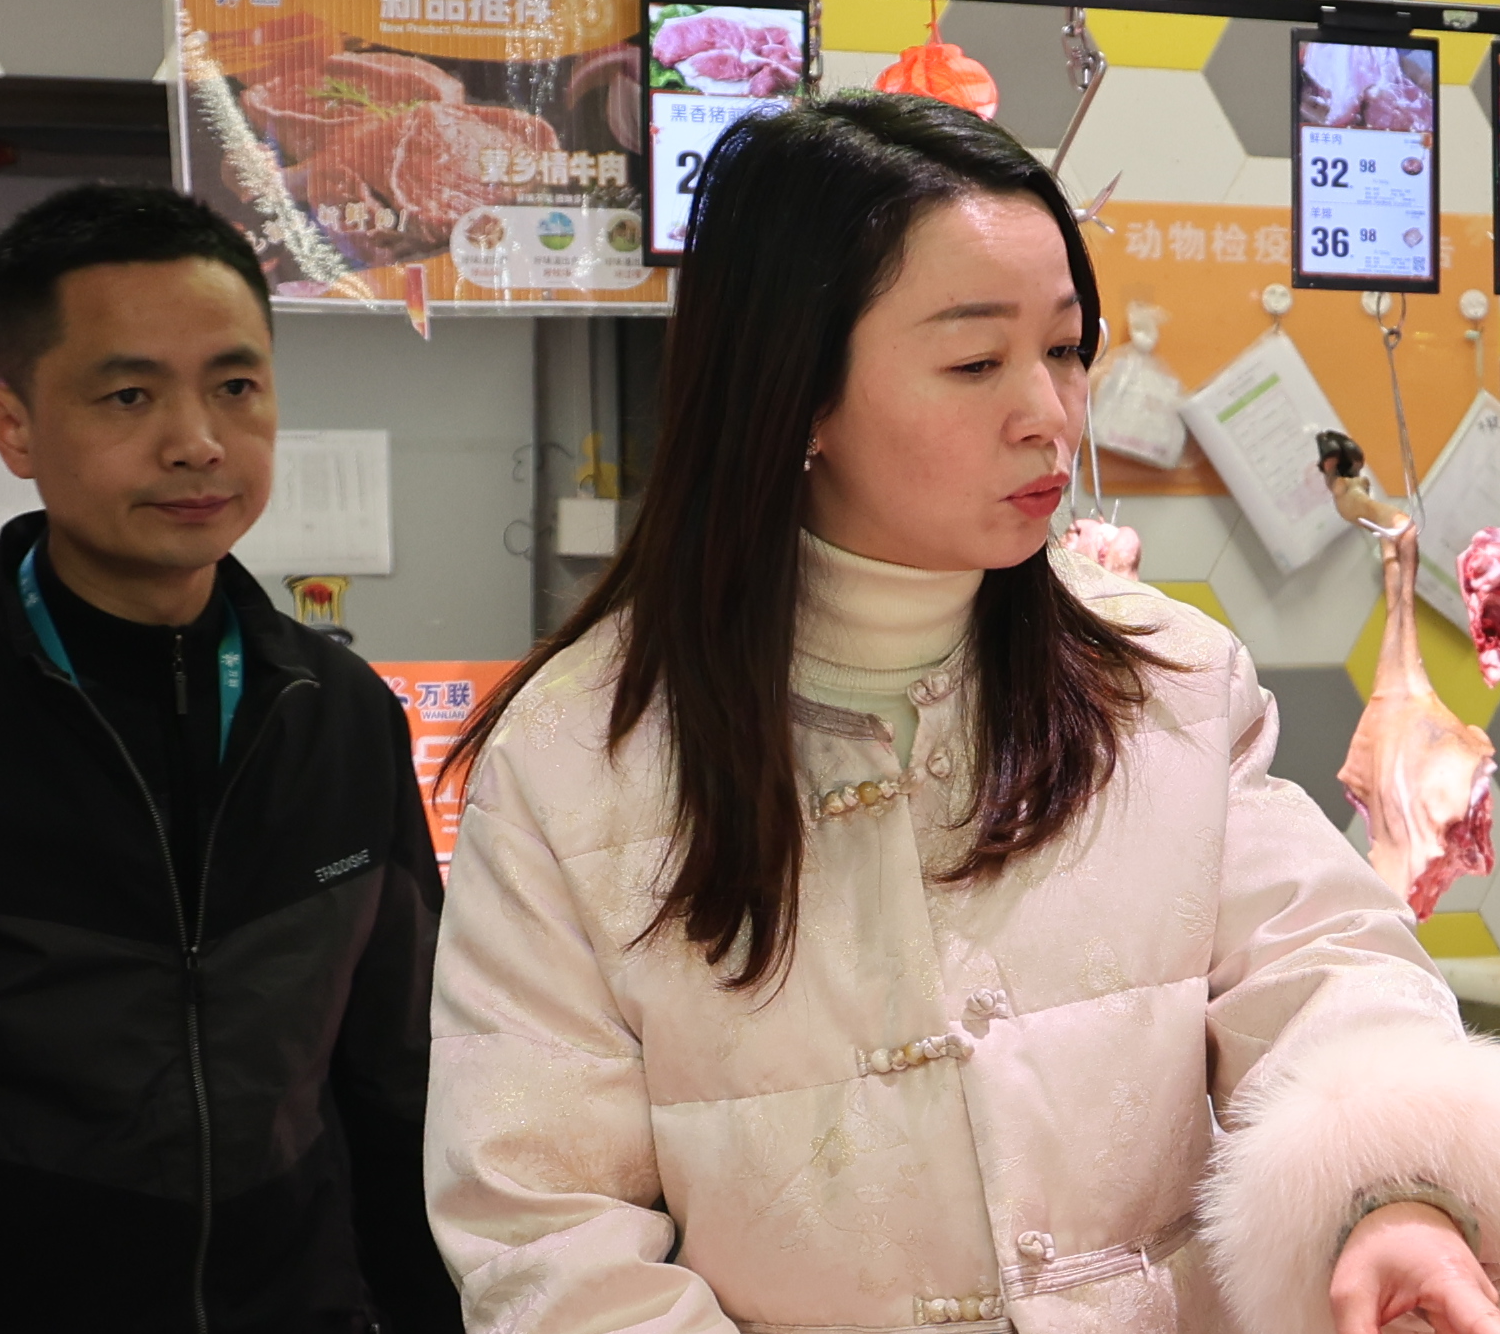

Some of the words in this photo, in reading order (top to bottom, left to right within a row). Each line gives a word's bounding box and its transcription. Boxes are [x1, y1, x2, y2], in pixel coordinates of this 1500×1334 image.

[1310, 131, 1342, 145] 鲜羊肉
[1359, 159, 1376, 173] 98
[1311, 207, 1332, 218] 羊排
[1360, 228, 1377, 242] 98
[417, 682, 472, 709] 万联
[422, 710, 467, 720] WANLIAN
